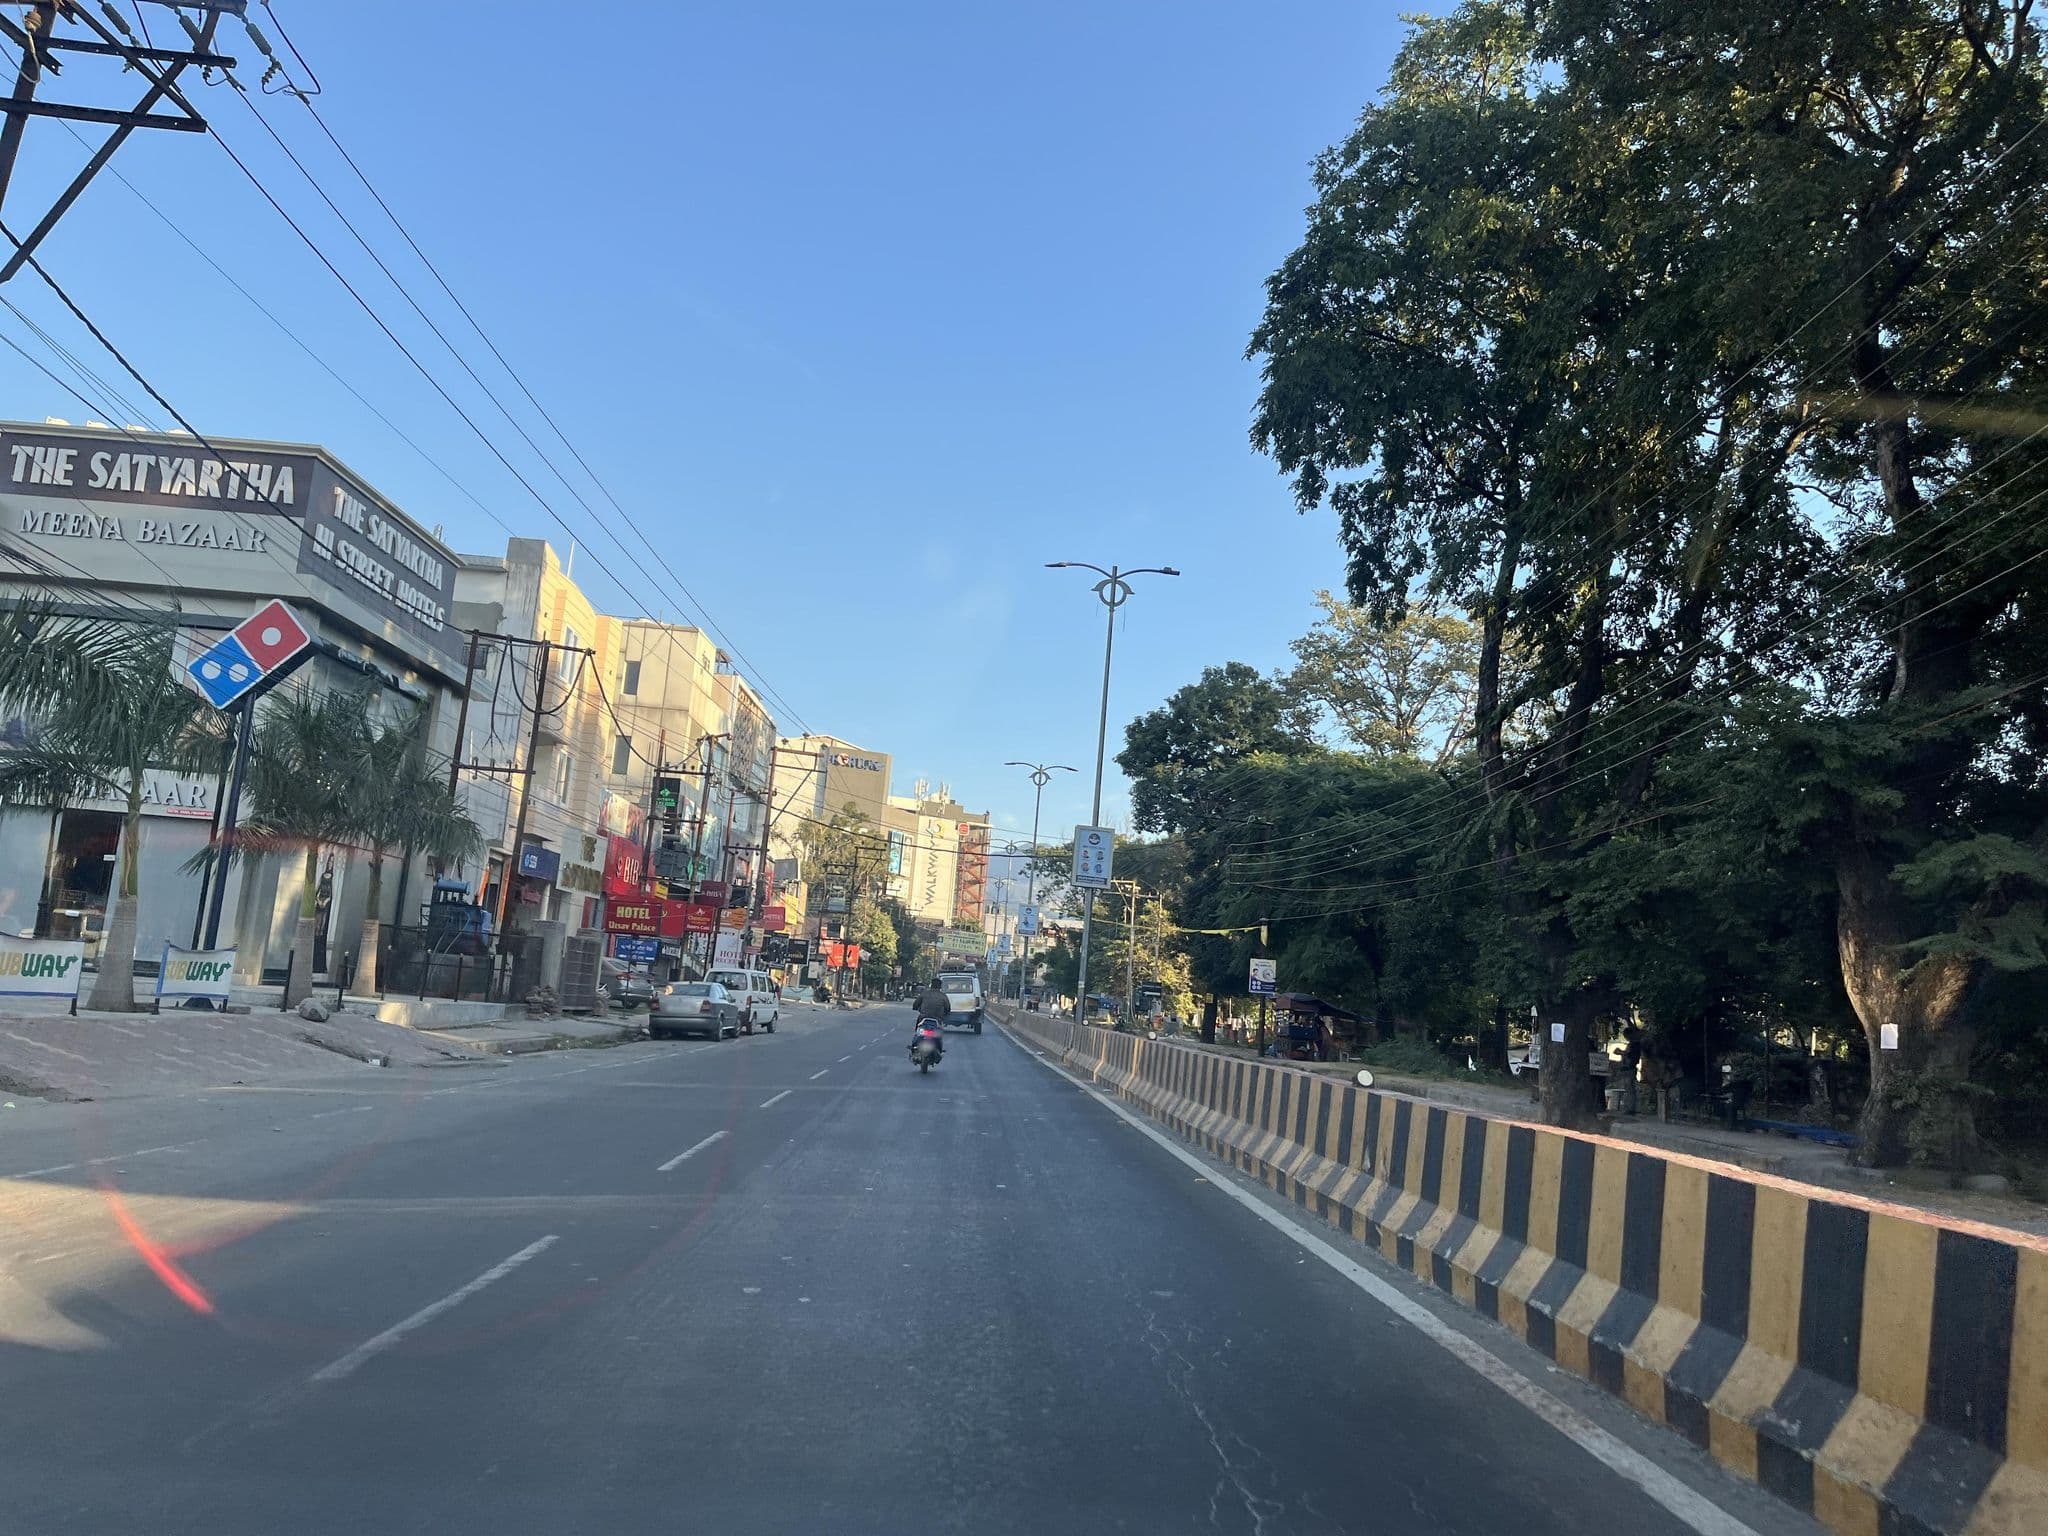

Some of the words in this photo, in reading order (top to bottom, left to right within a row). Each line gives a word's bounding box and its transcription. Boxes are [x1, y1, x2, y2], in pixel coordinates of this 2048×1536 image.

[11, 445, 78, 486] THE
[87, 451, 294, 505] SATYARTHA
[19, 508, 124, 541] MEENA
[136, 518, 268, 553] BAZAAR
[334, 486, 367, 535] THE
[366, 514, 443, 591] SATYARTHA
[312, 523, 335, 561] HI
[334, 540, 395, 601] STREET
[394, 579, 446, 633] HOTELS
[616, 906, 651, 919] HOTEL
[631, 922, 656, 932] Palace
[167, 960, 232, 982] SUBWAY
